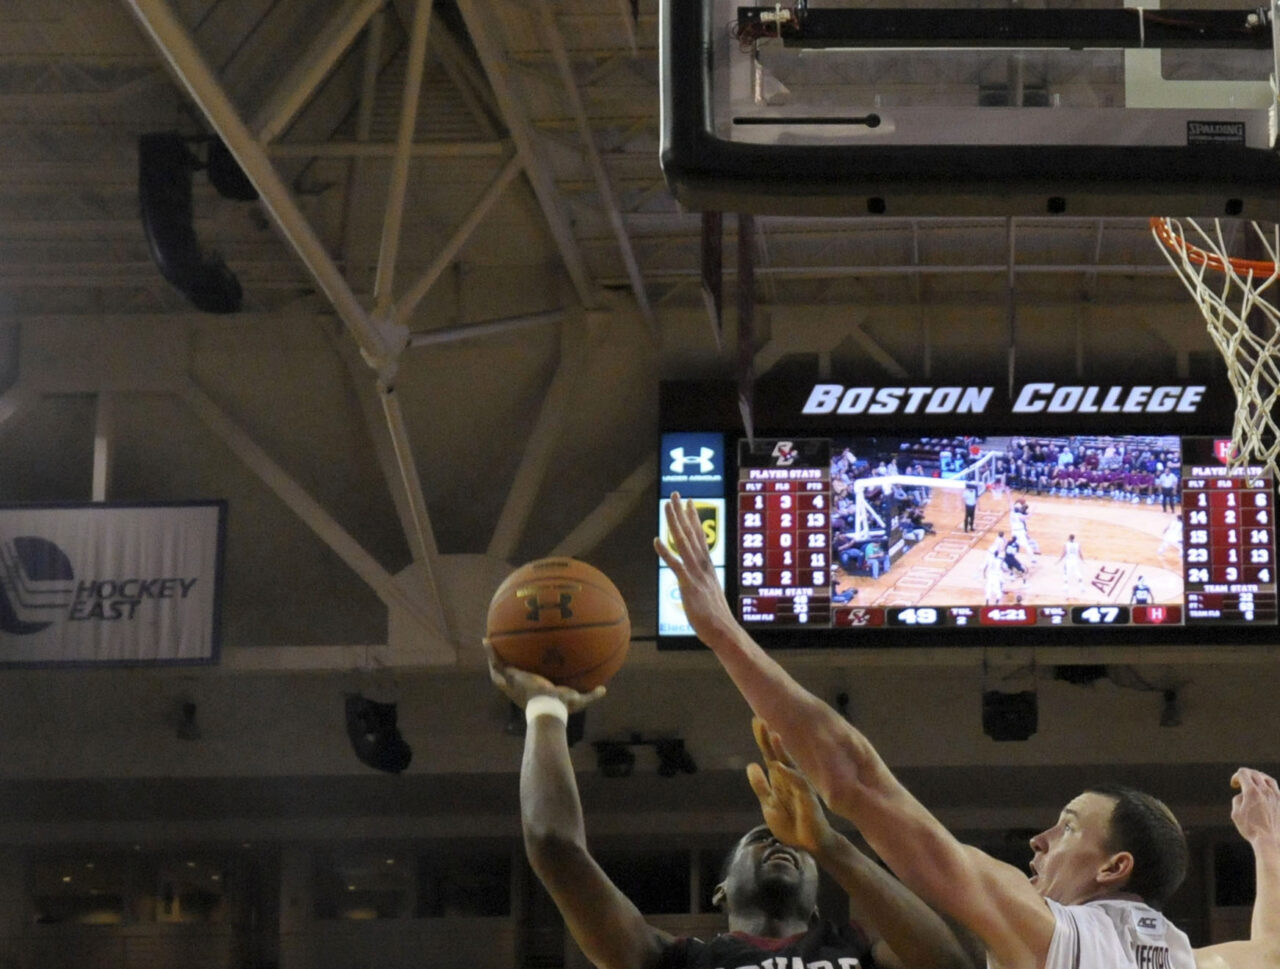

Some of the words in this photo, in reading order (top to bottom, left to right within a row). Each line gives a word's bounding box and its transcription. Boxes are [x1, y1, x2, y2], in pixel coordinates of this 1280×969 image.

[801, 384, 994, 415] BOSTON
[1013, 383, 1206, 414] COLLEGE
[750, 470, 788, 480] PLAYER
[789, 469, 821, 479] STATS
[1192, 467, 1227, 476] PLAYE
[754, 495, 763, 509] 1
[780, 495, 792, 509] 3
[812, 495, 824, 509] 4
[1198, 493, 1207, 507] 1
[1226, 493, 1236, 507] 1
[744, 513, 762, 527] 21
[780, 513, 792, 527] 2
[807, 513, 825, 527] 13
[1189, 510, 1207, 525] 14
[1224, 509, 1236, 523] 2
[1256, 510, 1268, 524] 4
[743, 533, 763, 548] 22
[780, 533, 792, 547] 0
[808, 533, 826, 548] 12
[1190, 530, 1208, 544] 15
[1228, 529, 1237, 543] 1
[1251, 529, 1268, 544] 14
[743, 552, 763, 567] 24
[783, 551, 792, 565] 1
[810, 553, 826, 567] 11
[1187, 548, 1208, 562] 23
[1229, 548, 1238, 562] 1
[1251, 548, 1269, 563] 13
[742, 571, 763, 586] 33
[780, 571, 792, 585] 2
[813, 571, 825, 585] 5
[1188, 568, 1209, 582] 24
[1225, 567, 1238, 581] 3
[1258, 568, 1270, 582] 4
[75, 577, 198, 599] HOCKEY
[758, 588, 783, 596] TEAM
[1203, 585, 1228, 593] TEAM
[69, 600, 142, 621] EAST
[898, 608, 937, 624] 49
[987, 609, 1026, 621] 4:21
[1081, 607, 1119, 623] 47
[1151, 607, 1163, 619] H
[956, 616, 967, 625] 2
[1051, 615, 1062, 624] 2
[1137, 917, 1157, 928] ACC
